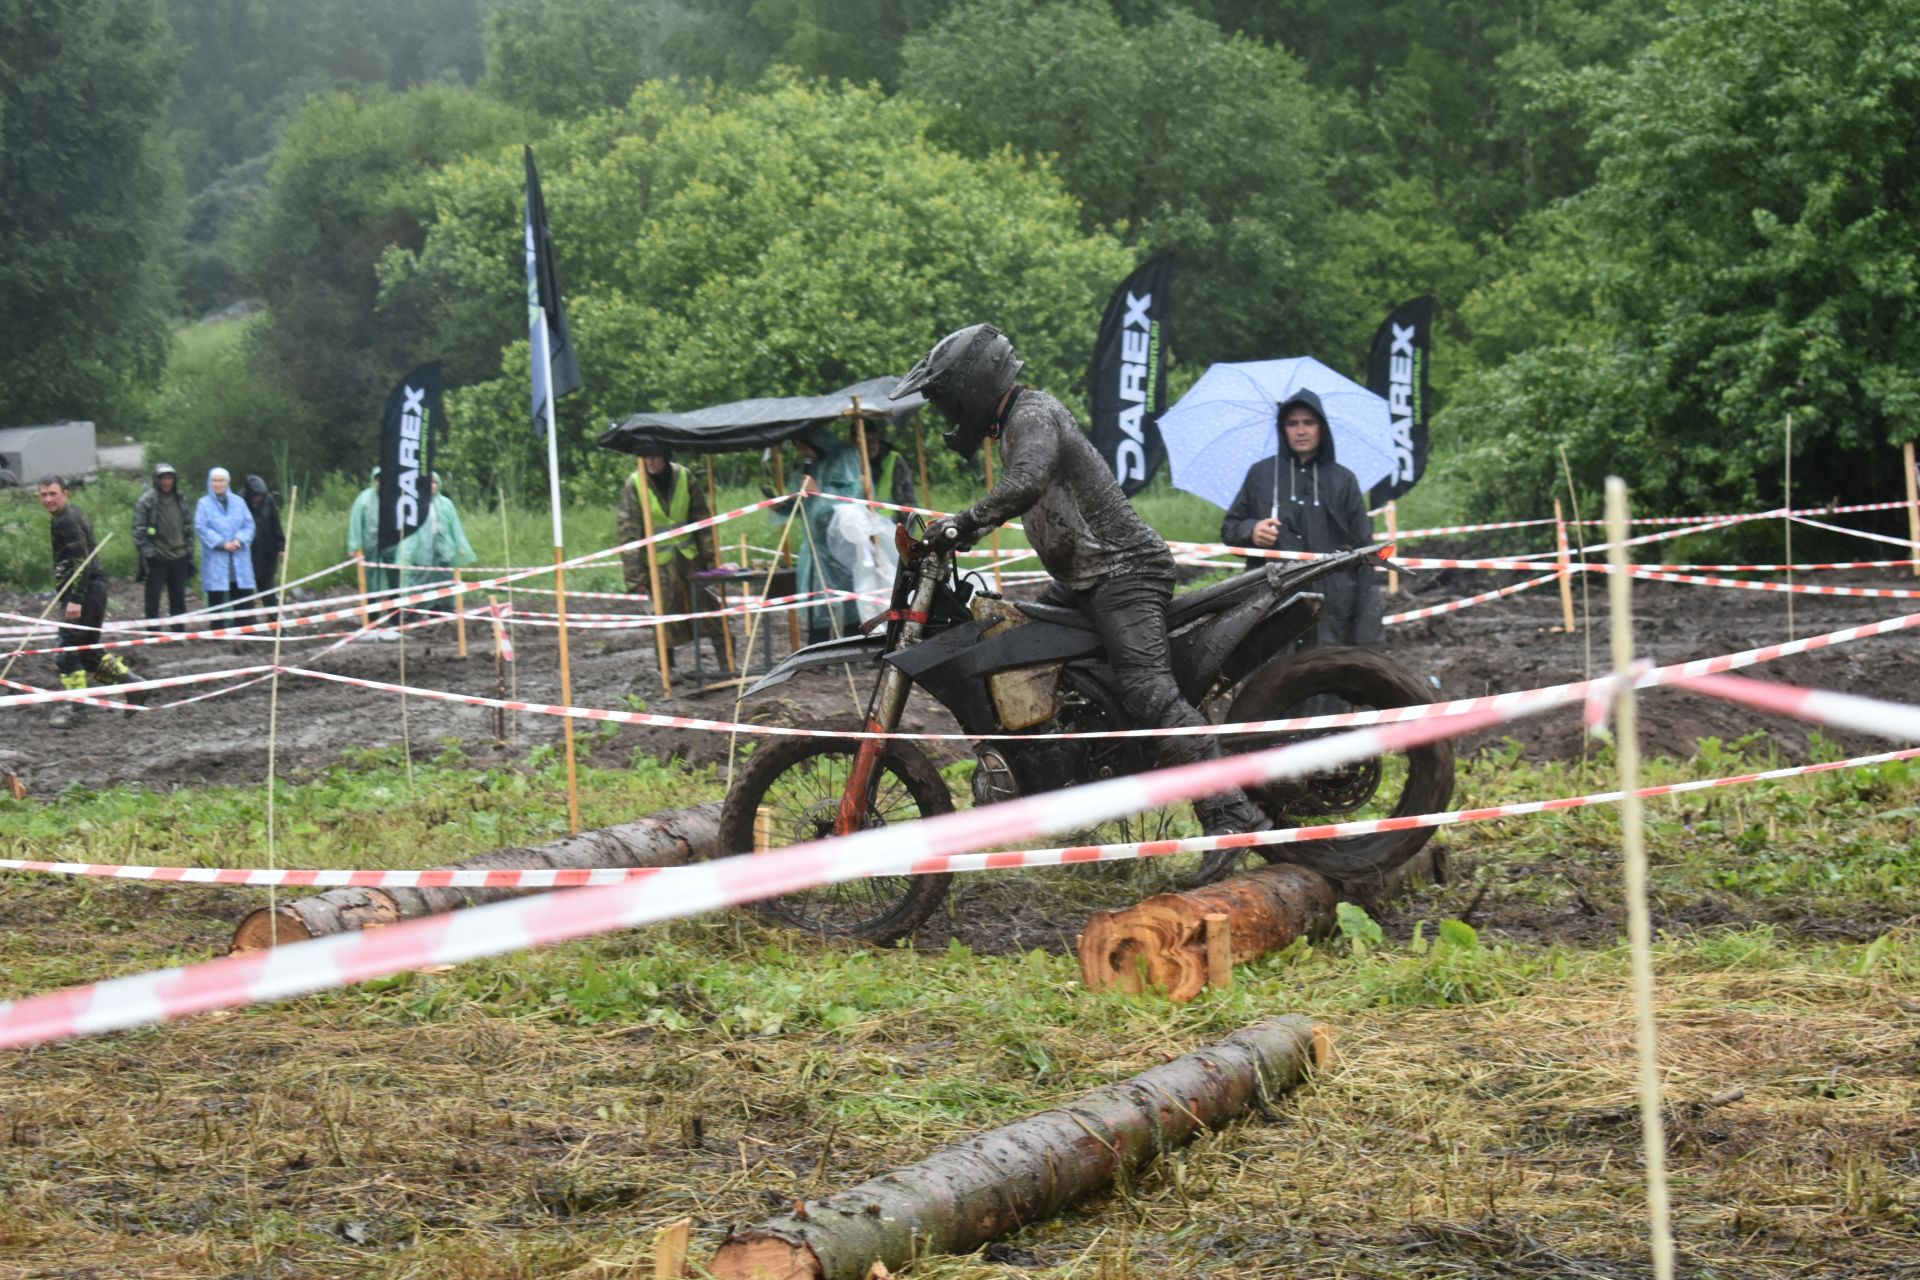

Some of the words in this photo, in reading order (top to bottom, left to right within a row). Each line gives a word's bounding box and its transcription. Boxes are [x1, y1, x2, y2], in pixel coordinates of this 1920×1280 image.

[1116, 290, 1152, 486] DAREX
[1147, 320, 1160, 413] DAREXMOTO.RU
[1389, 322, 1415, 487] DAREX
[396, 384, 425, 530] DAREX
